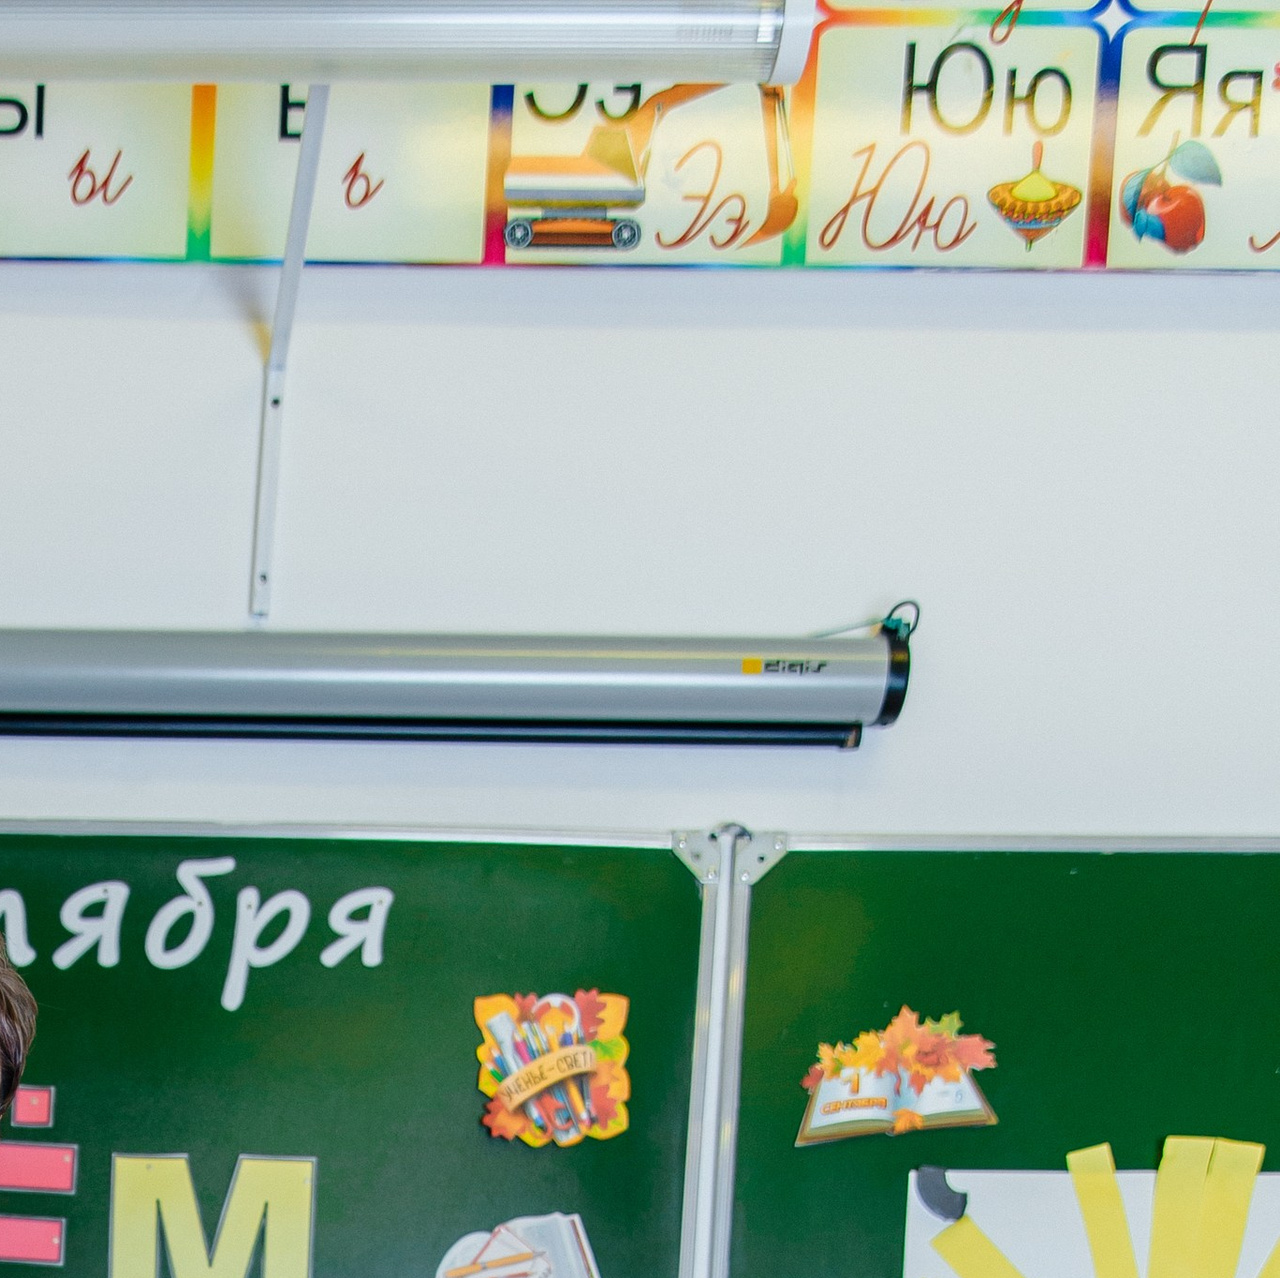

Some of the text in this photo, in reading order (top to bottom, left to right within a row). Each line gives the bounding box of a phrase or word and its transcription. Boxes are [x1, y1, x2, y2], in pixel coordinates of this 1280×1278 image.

[899, 41, 1072, 137] Юю
[1136, 43, 1264, 138] Яя
[655, 140, 751, 249] Ээ
[818, 139, 978, 251] Юю
